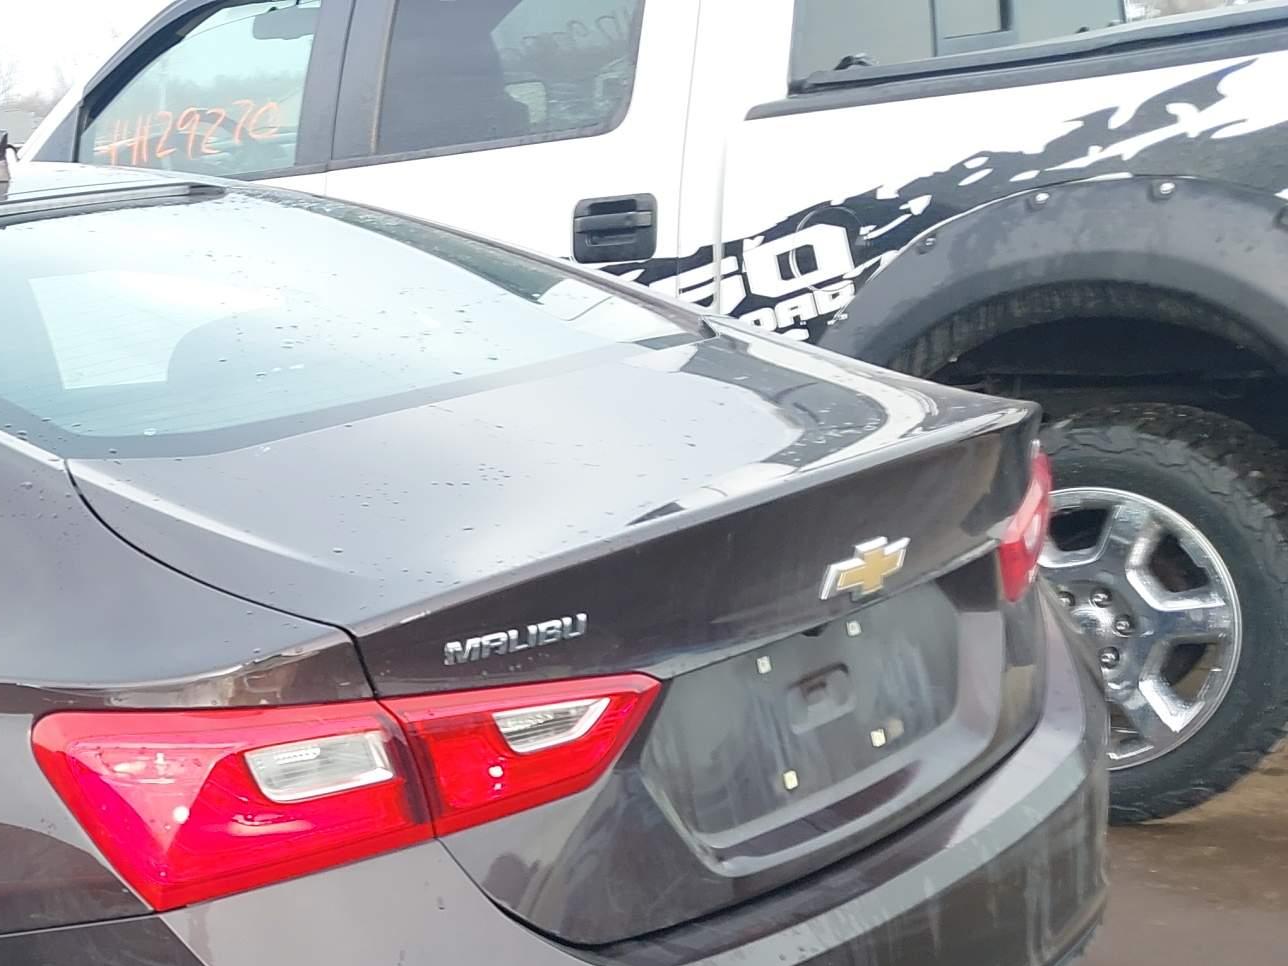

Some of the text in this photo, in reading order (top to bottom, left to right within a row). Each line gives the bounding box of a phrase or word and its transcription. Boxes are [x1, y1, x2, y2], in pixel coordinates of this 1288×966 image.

[649, 223, 856, 314] 50
[738, 279, 856, 333] OAD
[443, 612, 588, 666] MALIBU
